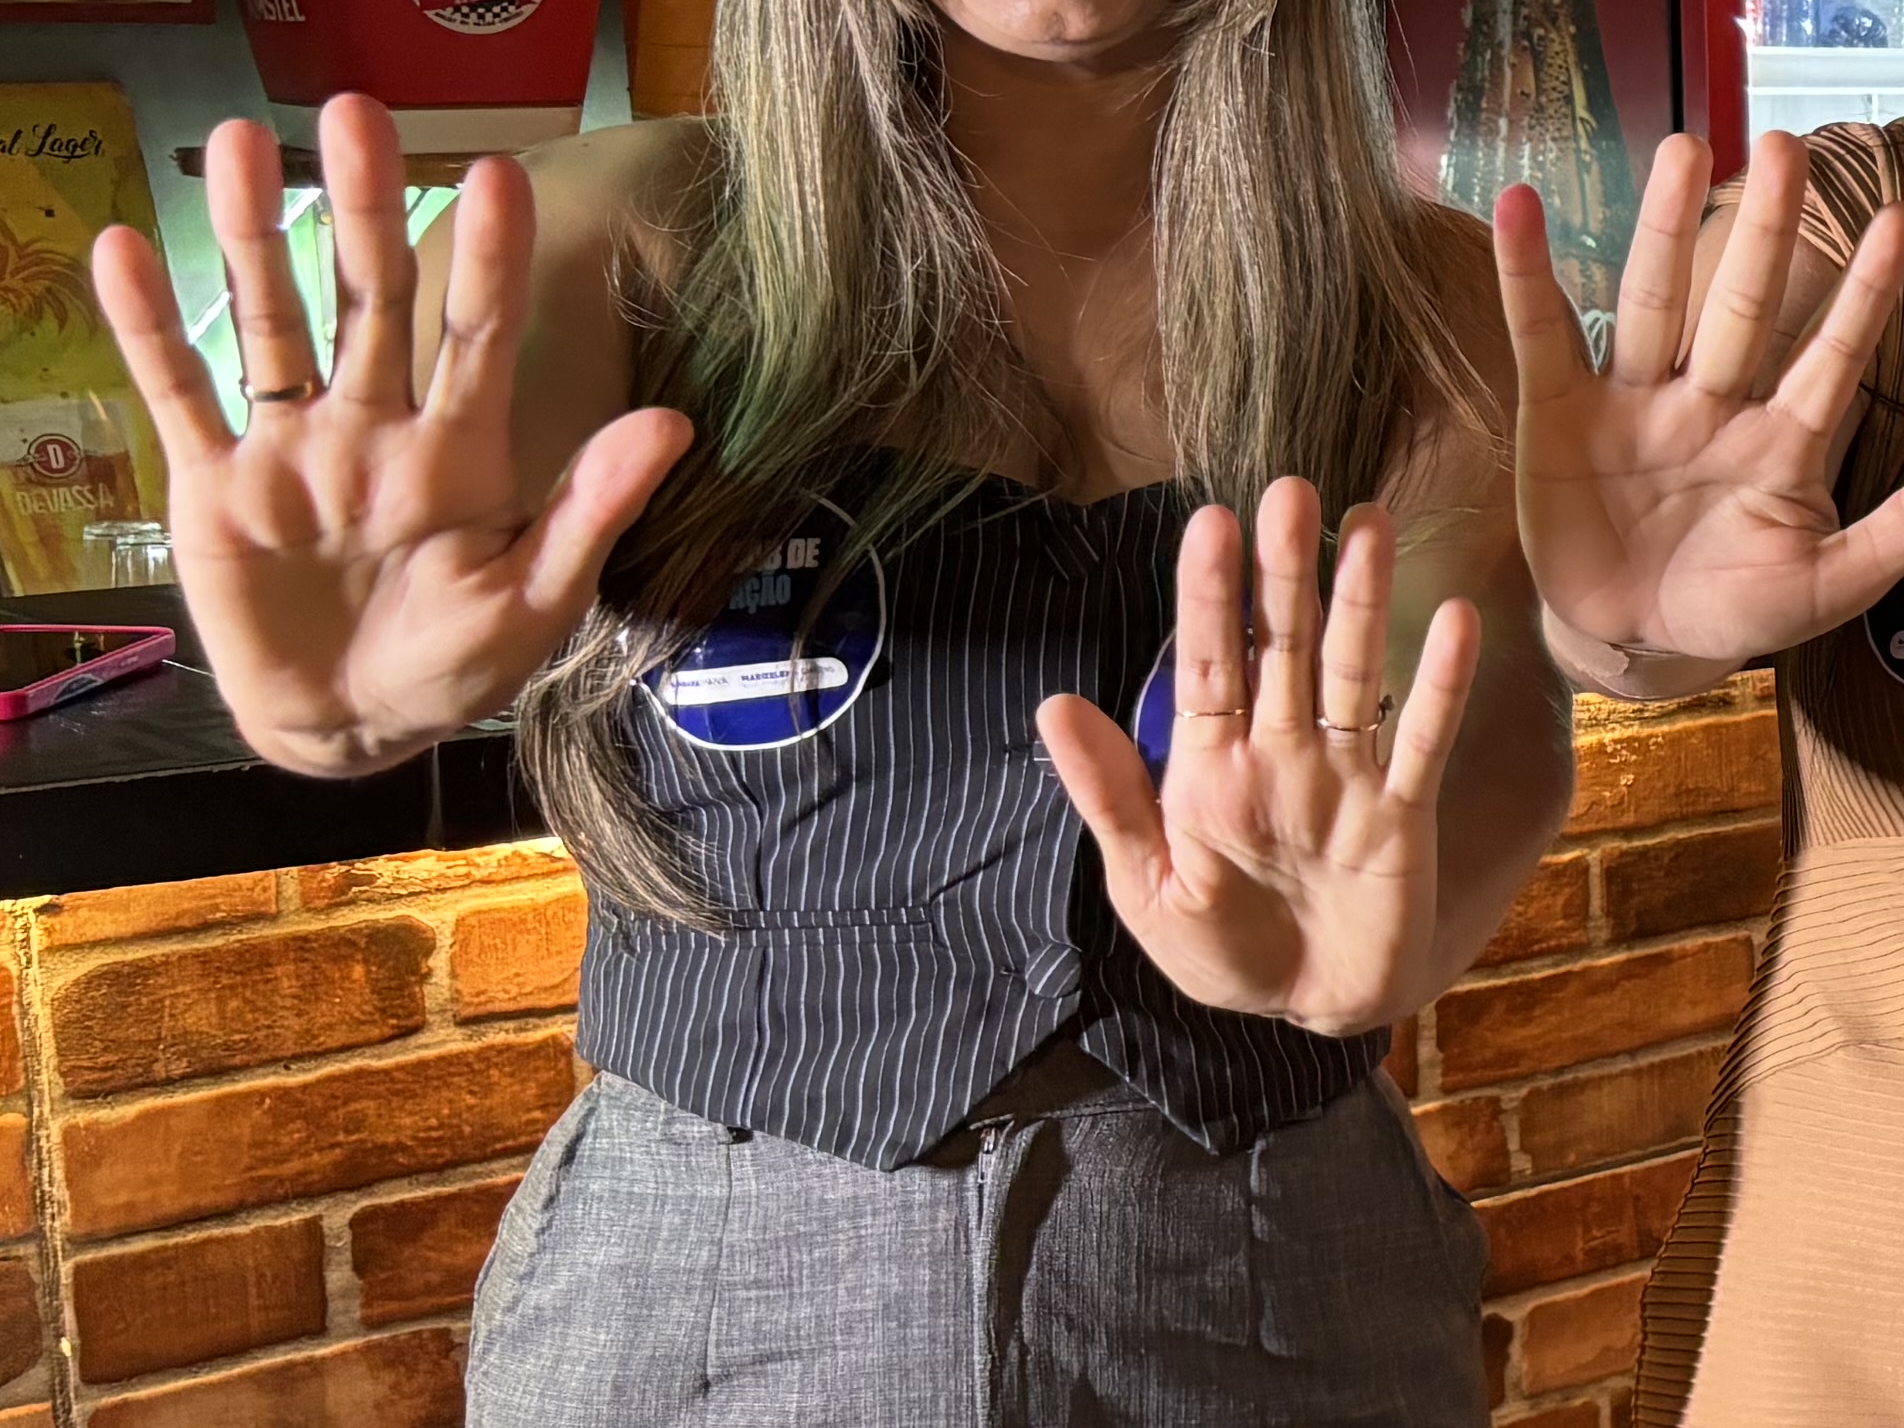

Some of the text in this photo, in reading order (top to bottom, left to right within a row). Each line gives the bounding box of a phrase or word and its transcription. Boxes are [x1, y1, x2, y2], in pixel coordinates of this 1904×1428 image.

[24, 123, 104, 164] Lager
[16, 482, 116, 517] DEVASSA
[786, 537, 822, 569] DE
